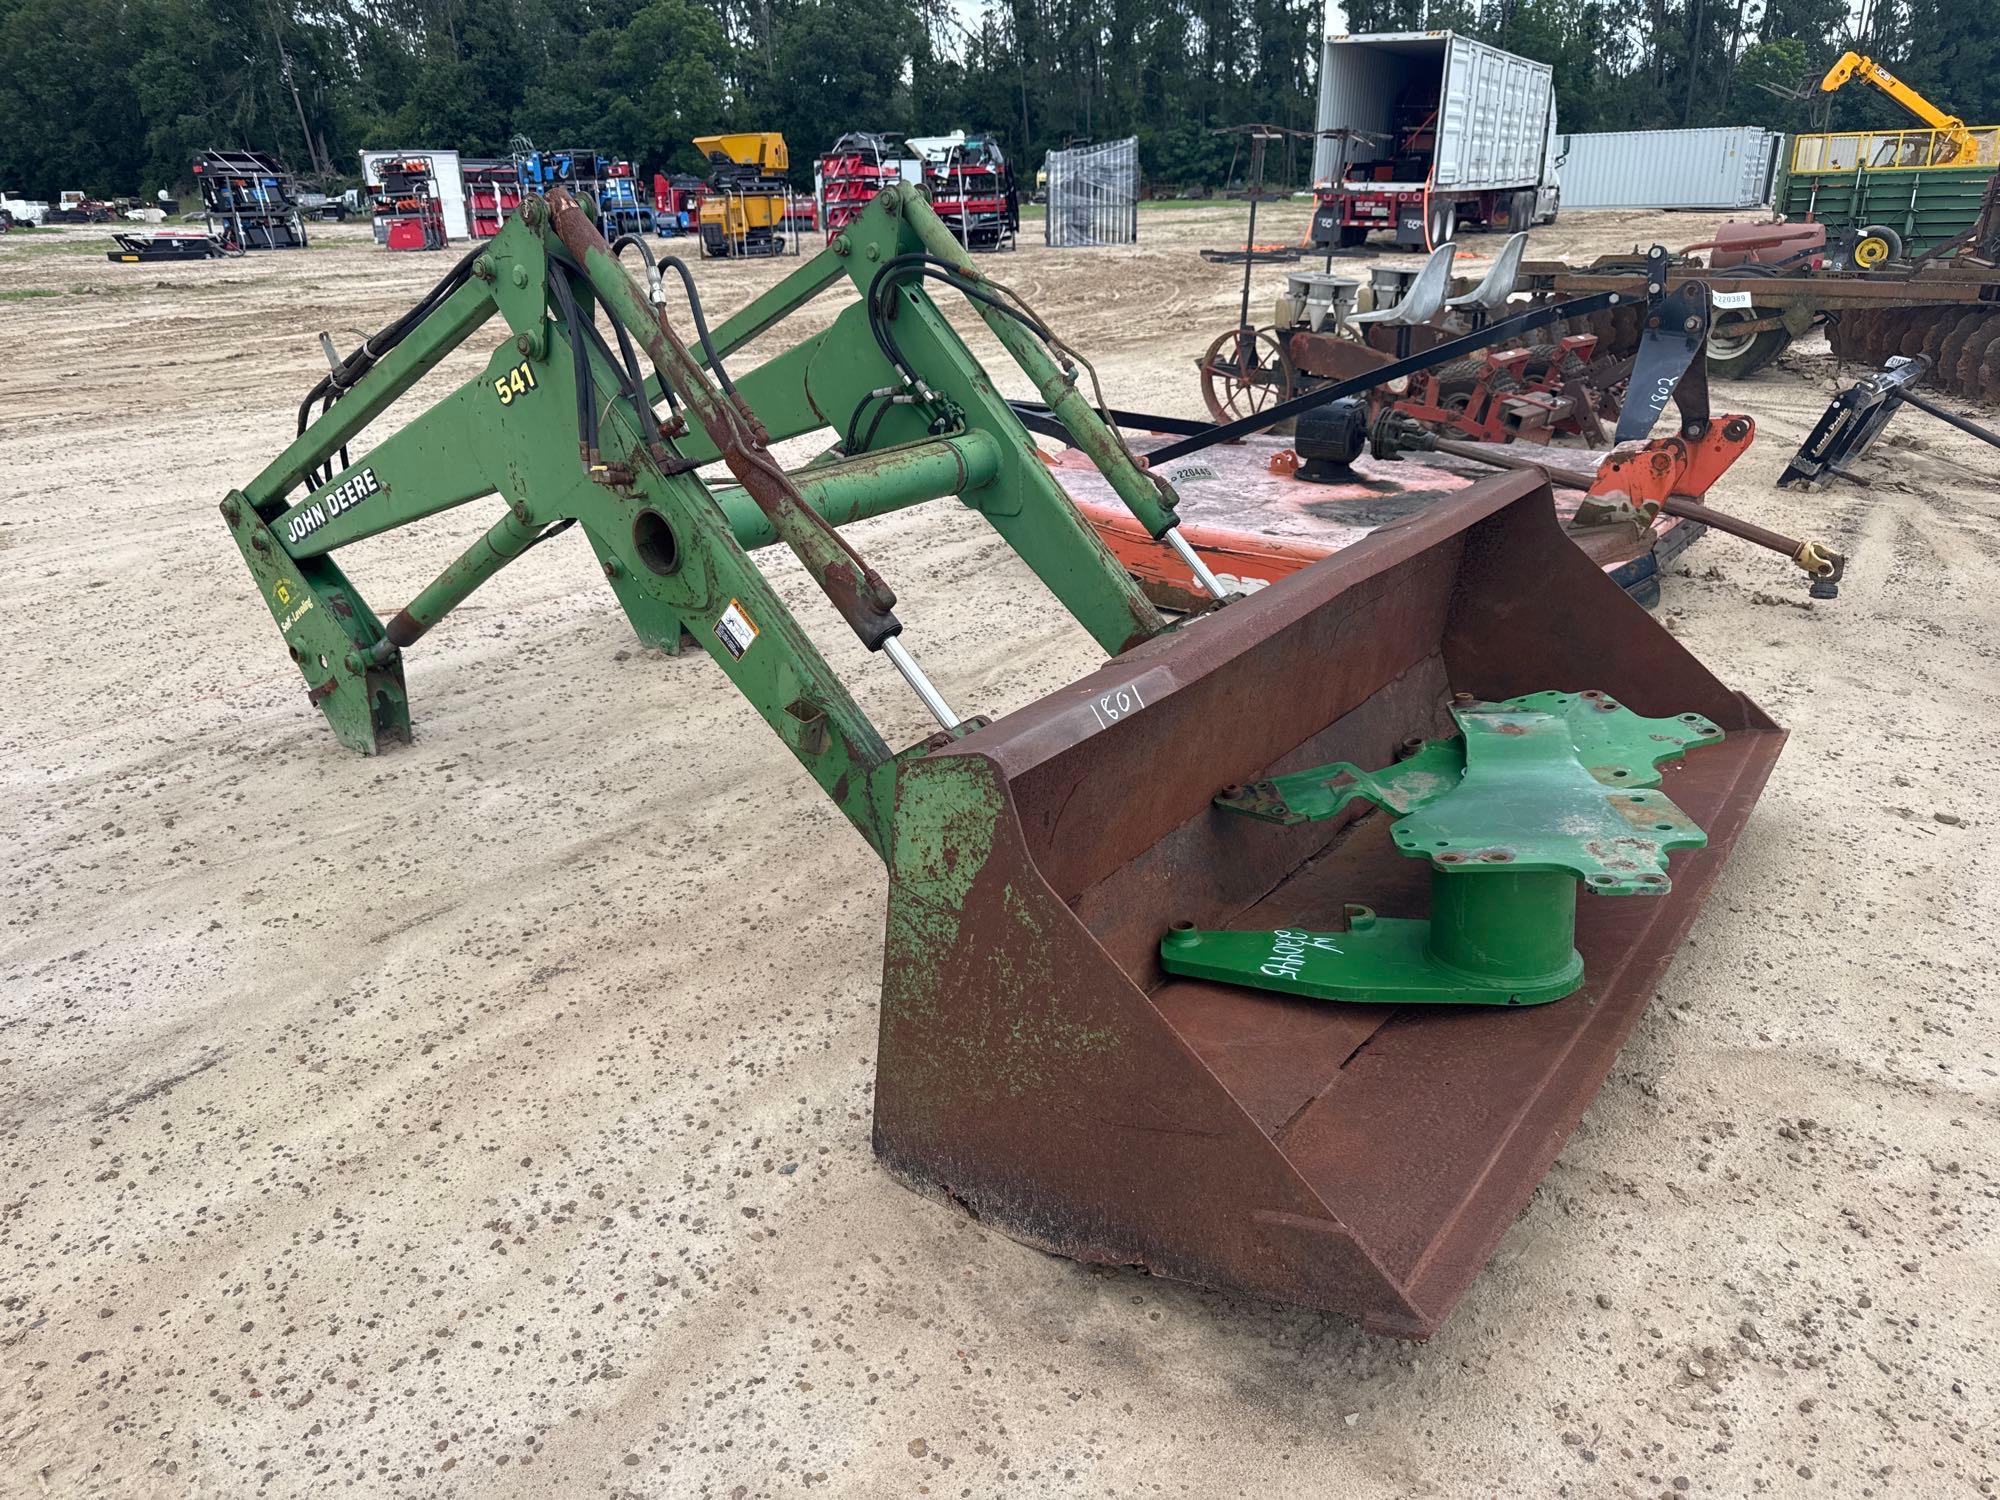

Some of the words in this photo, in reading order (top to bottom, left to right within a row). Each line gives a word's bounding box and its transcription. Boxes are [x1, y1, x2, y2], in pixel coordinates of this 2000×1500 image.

[1875, 67, 1891, 81] JCB
[494, 361, 536, 405] 541
[1649, 376, 1679, 411] 1802
[1176, 467, 1212, 479] 220445
[287, 501, 327, 543] JOHN
[325, 467, 379, 517] DEERE
[1090, 684, 1145, 730] 1801
